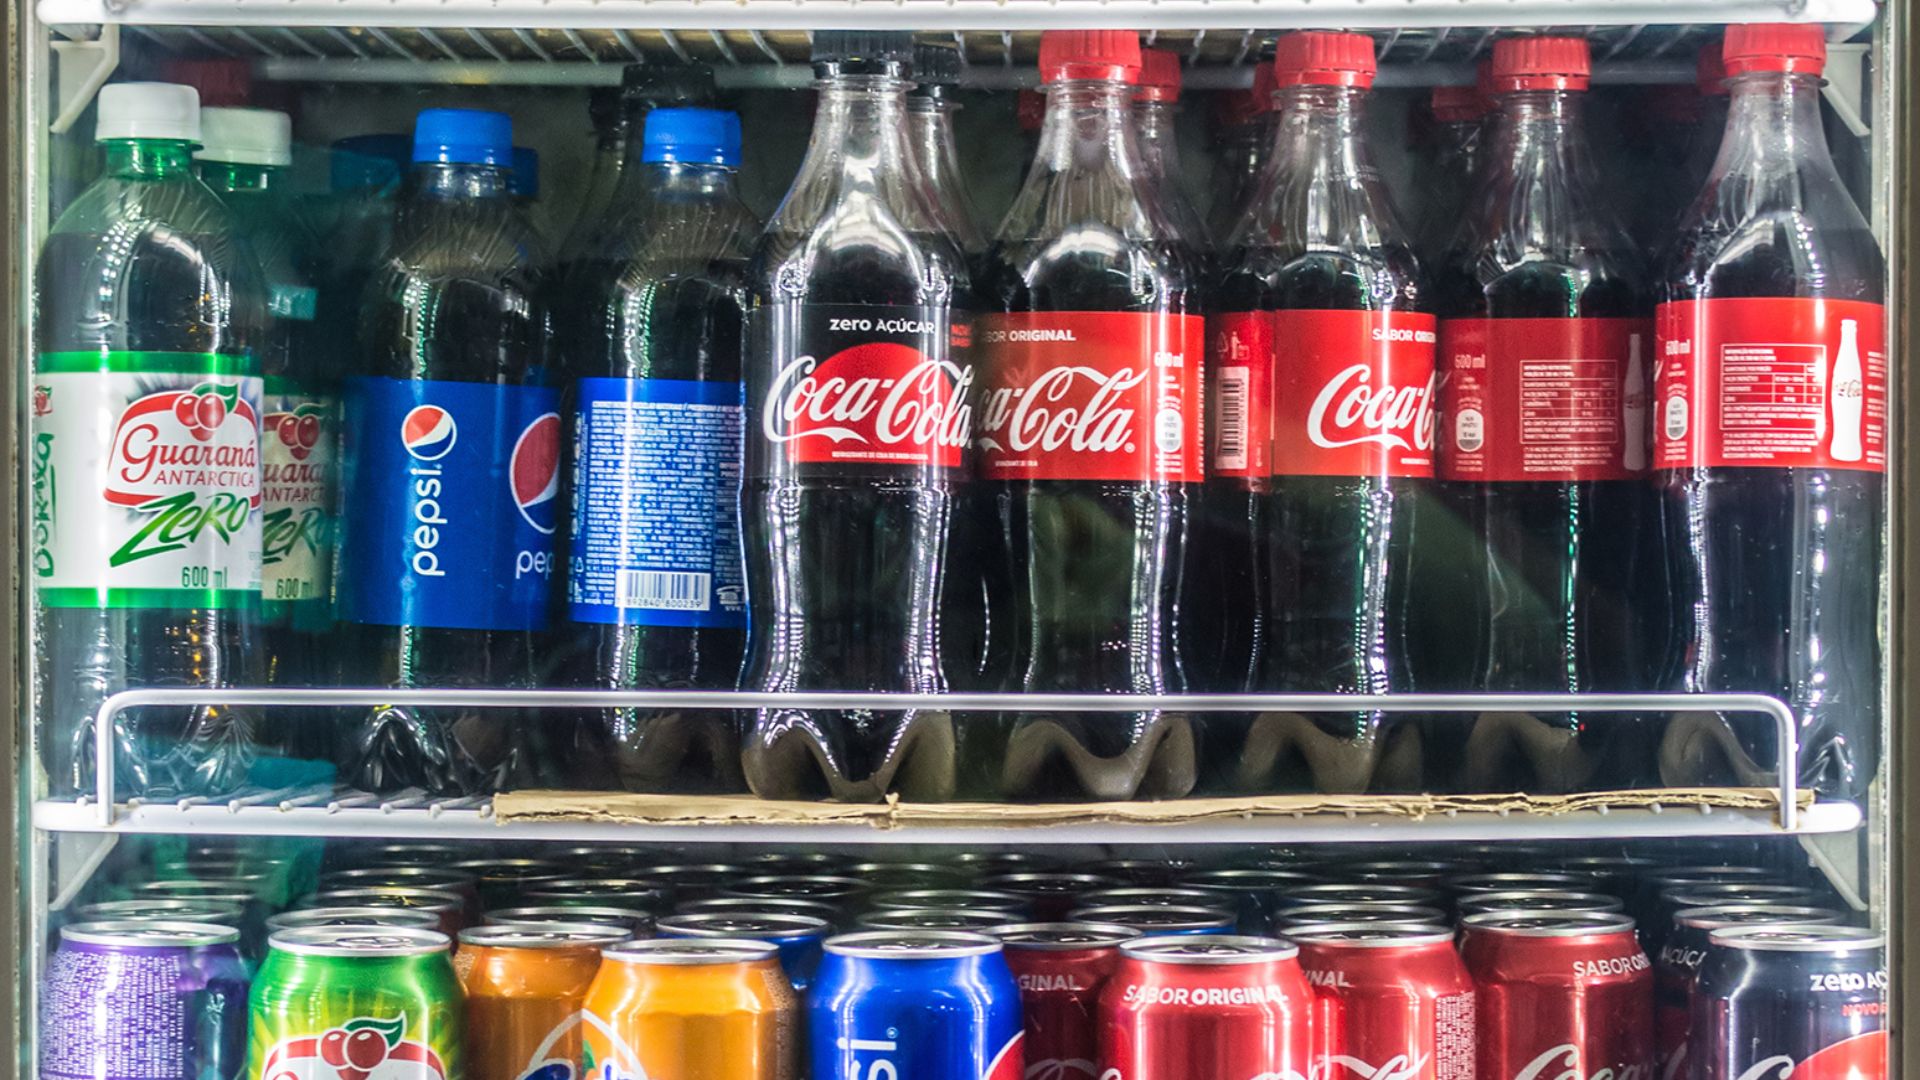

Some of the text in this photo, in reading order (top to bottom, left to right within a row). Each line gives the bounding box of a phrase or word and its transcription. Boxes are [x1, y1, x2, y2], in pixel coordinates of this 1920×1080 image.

[829, 318, 871, 331] zero
[876, 317, 935, 334] AÇÚCAR
[1009, 329, 1077, 341] ORIGINAL
[1372, 328, 1413, 341] SABOR
[763, 355, 975, 448] Coca-Cola
[1307, 363, 1436, 450] Coca-C
[121, 423, 256, 483] Guaraná
[153, 470, 254, 487] ANTARCTICA
[410, 468, 448, 577] pepsi
[515, 550, 555, 580] pep
[181, 566, 209, 588] 600
[213, 566, 228, 589] ml
[276, 578, 299, 599] 600
[1572, 956, 1634, 978] SABOR
[1018, 974, 1081, 992] GINAL
[1123, 984, 1289, 1006] SABOR ORIGINAL
